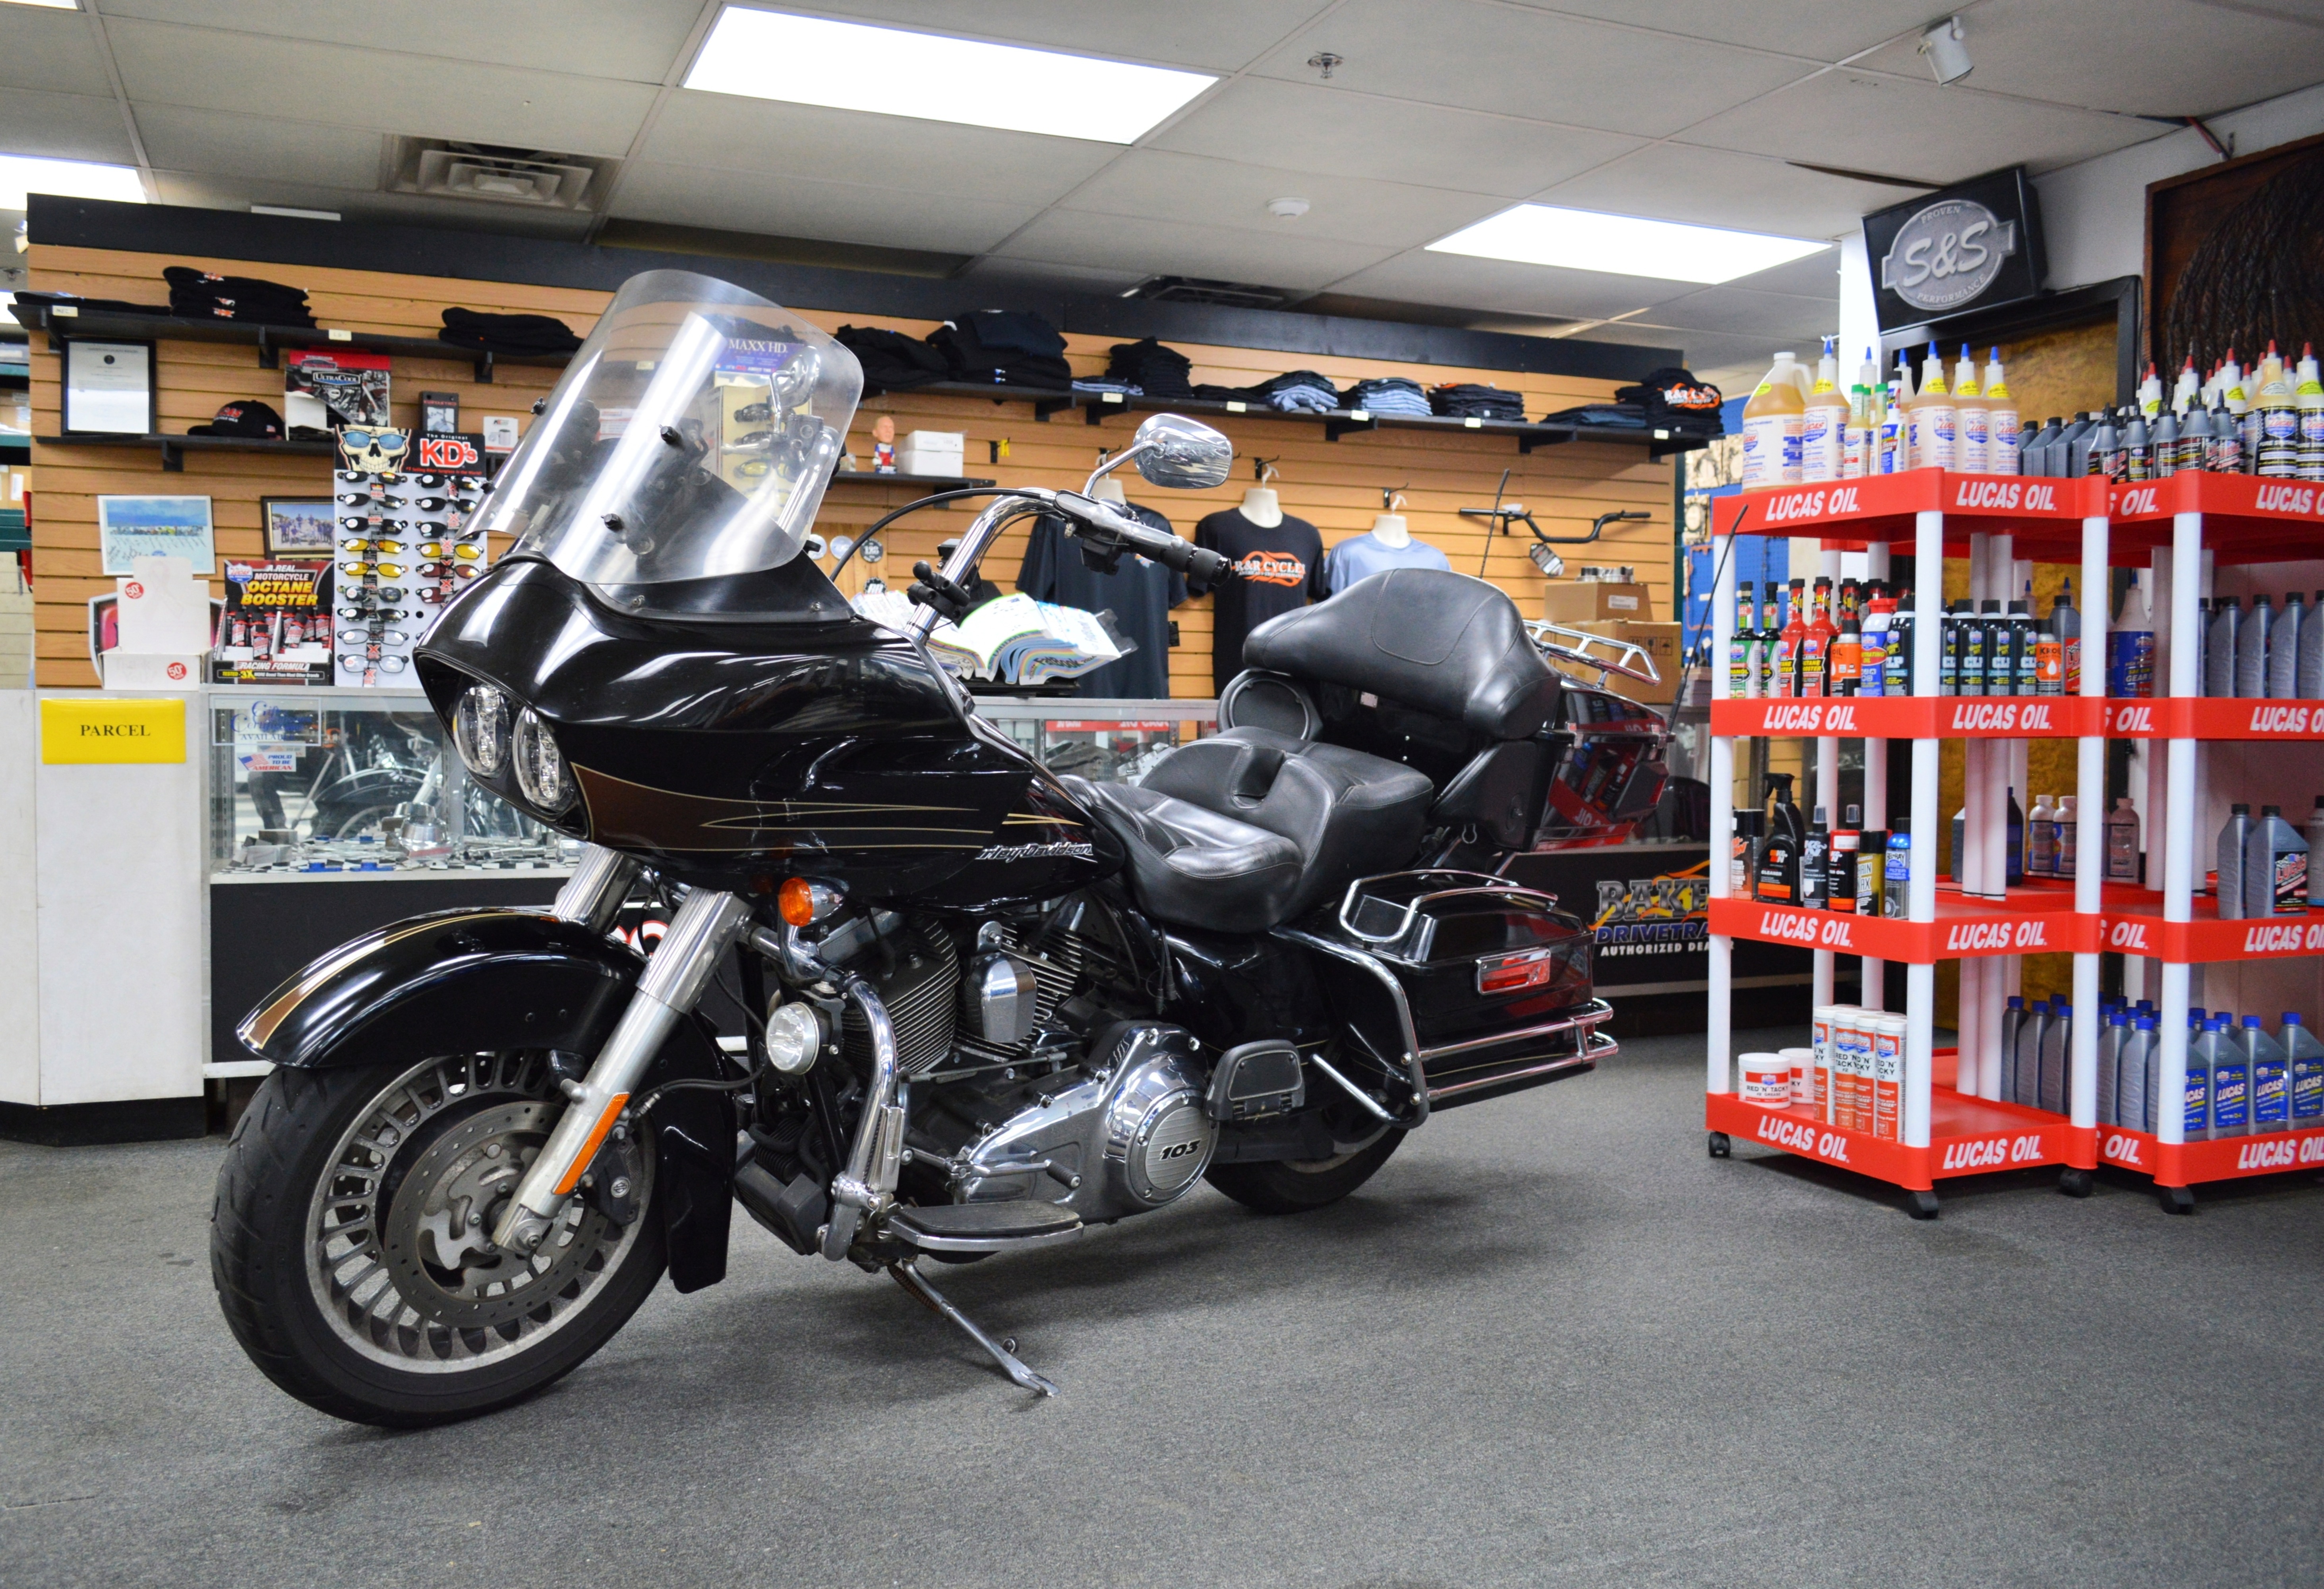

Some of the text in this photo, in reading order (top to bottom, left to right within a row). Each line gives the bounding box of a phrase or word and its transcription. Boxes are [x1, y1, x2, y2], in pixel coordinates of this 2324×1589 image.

[1921, 205, 1962, 224] PROVEN
[1903, 221, 1989, 287] S&S
[1916, 274, 1987, 304] PERFORMANCE
[729, 339, 766, 352] MAXX
[1765, 487, 1858, 521] LUCAS OIL
[1956, 481, 2055, 511] LUCAS OIL
[2121, 487, 2156, 516] OIL
[2256, 485, 2314, 516] LUCAS
[254, 572, 309, 581] MOTORCYCLE
[1235, 561, 1261, 572] R&R
[247, 580, 314, 593] OCTANE
[240, 593, 318, 606] BOOSTER
[239, 662, 310, 671] RACING FORMULA
[1763, 706, 1856, 730] LUCAS OIL
[1952, 704, 2050, 730] LUCAS OIL
[2116, 707, 2151, 732] OIL
[2249, 707, 2308, 732] LUCAS
[80, 724, 151, 737] PARCEL
[1595, 878, 1710, 922] BAKE
[1595, 922, 1709, 944] DRIVETRA
[1760, 912, 1850, 947] LUCAS OIL
[1947, 922, 2045, 950] LUCAS OIL
[2111, 922, 2146, 949] OIL
[2244, 924, 2324, 952] LUCAS OI
[1600, 943, 1683, 957] AUTHORIZED
[2217, 1083, 2245, 1102] LUCAS
[2256, 1079, 2284, 1097] LUCAS
[2295, 1075, 2323, 1093] LUCAS
[1159, 1138, 1202, 1162] 103
[1757, 1115, 1848, 1162] LUCAS OIL
[2105, 1135, 2140, 1163] OIL
[1943, 1135, 2041, 1170] LUCAS OIL
[2237, 1139, 2296, 1169] LUCAS
